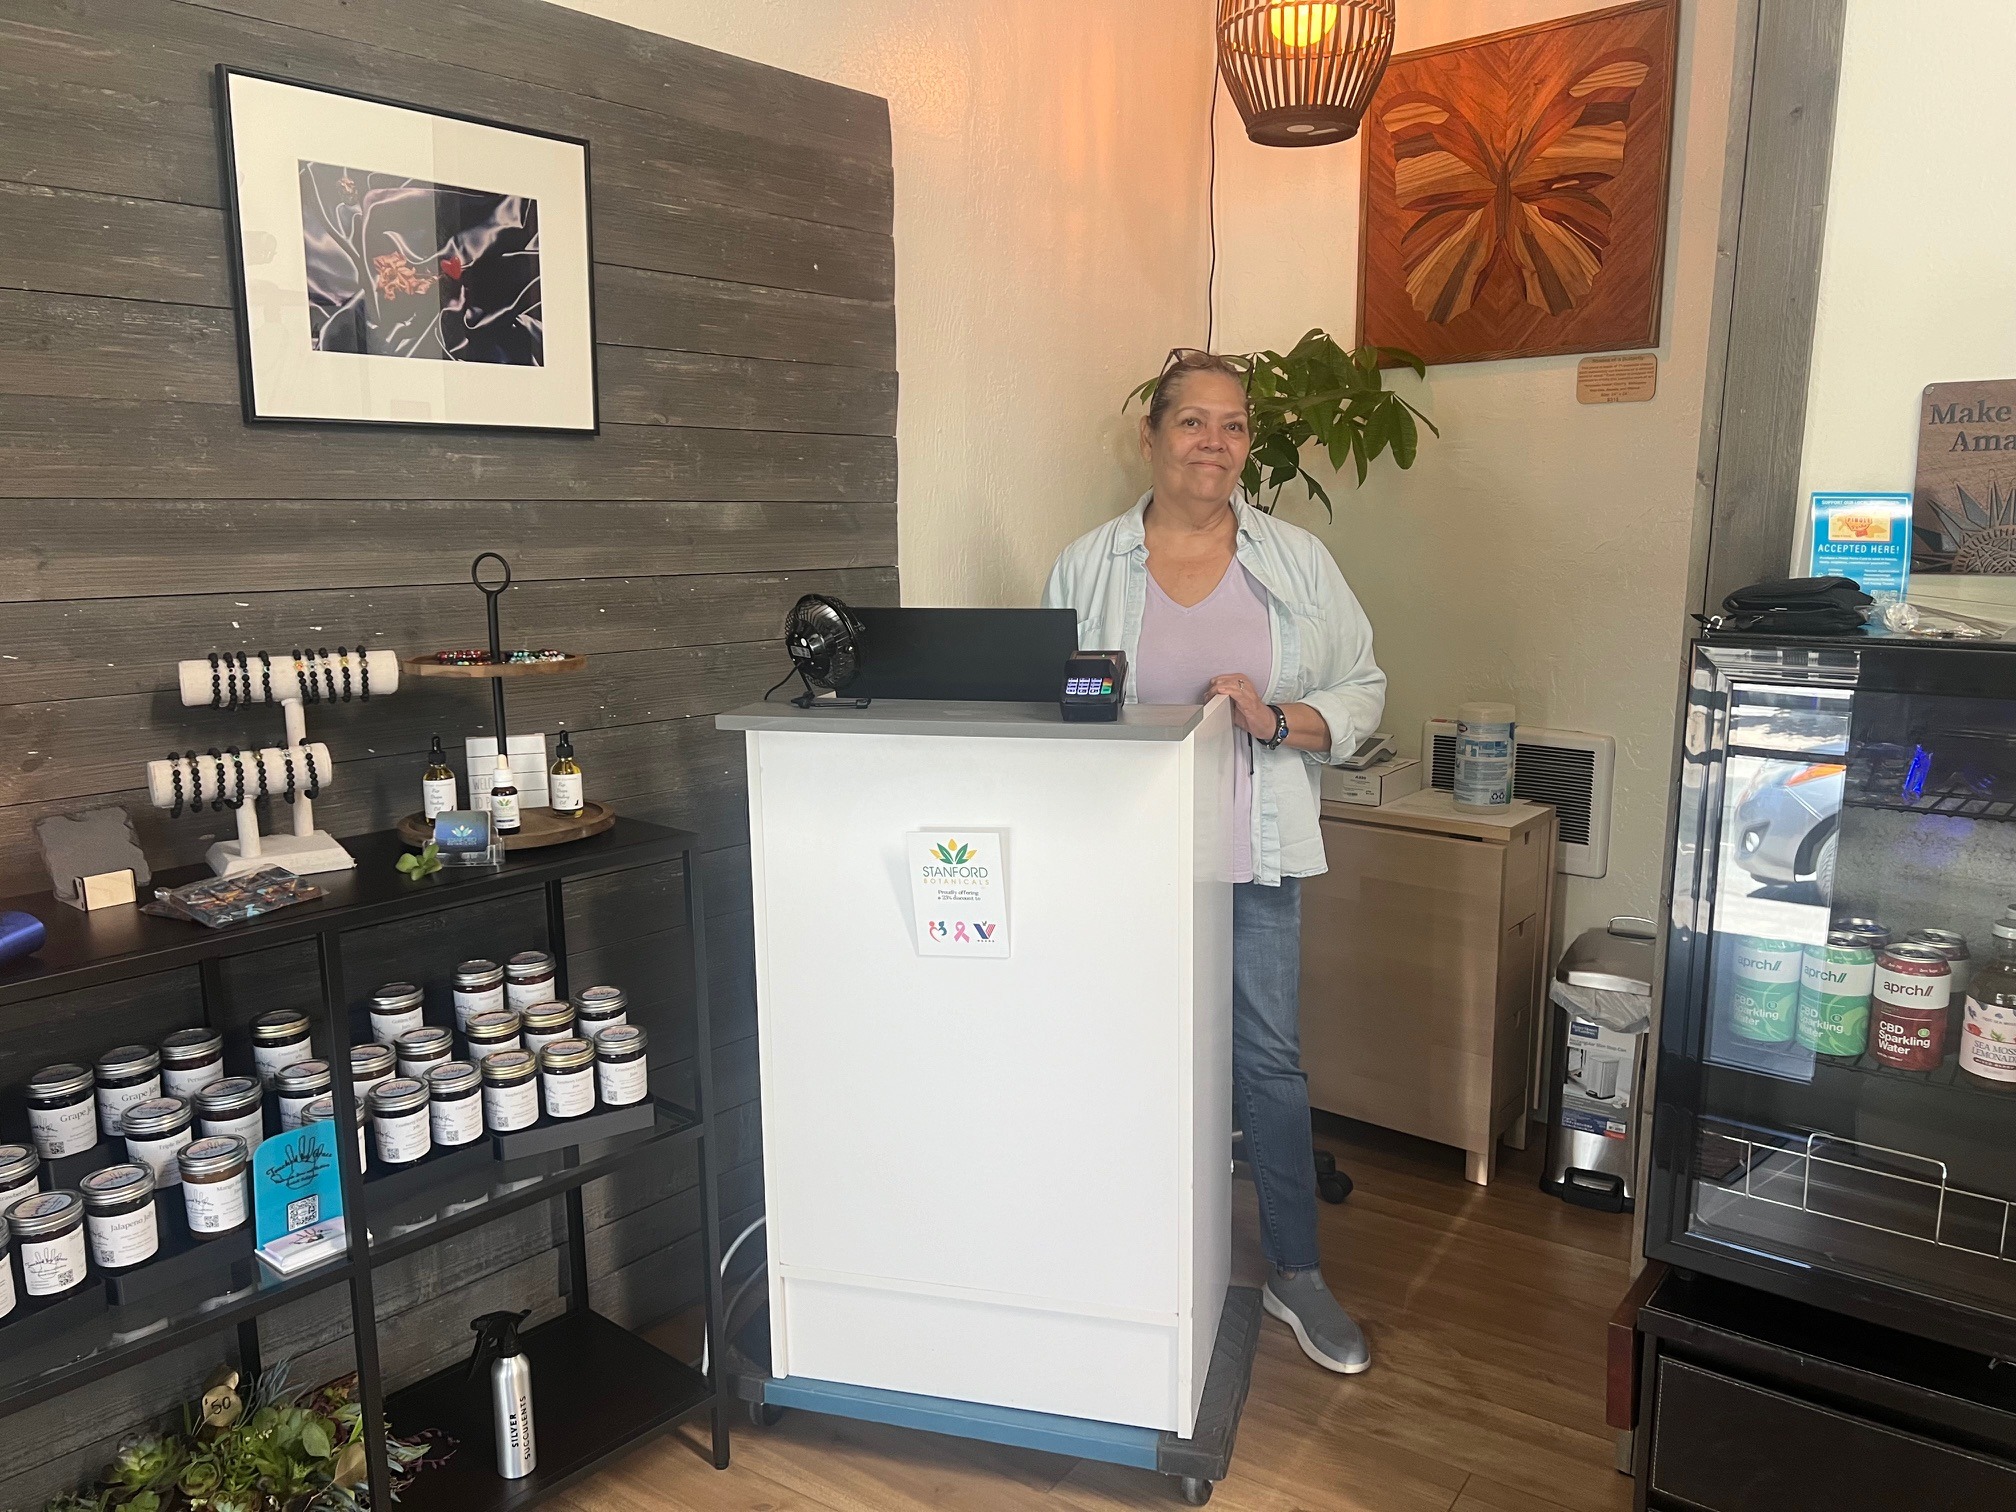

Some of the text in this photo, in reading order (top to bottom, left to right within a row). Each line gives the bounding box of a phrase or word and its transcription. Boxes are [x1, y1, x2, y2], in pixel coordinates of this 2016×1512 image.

[1929, 400, 2012, 426] Make
[1818, 544, 1900, 554] ACCEPTED HERE!
[922, 866, 988, 878] STANFORD
[1800, 1004, 1819, 1018] CBD
[1879, 1020, 1904, 1035] CBD
[1878, 1030, 1931, 1049] Sparkling
[1878, 1038, 1911, 1055] Water
[1973, 1040, 1991, 1052] SEA
[1971, 1046, 2016, 1063] LEMONAD
[121, 1089, 148, 1102] Grape
[60, 1109, 86, 1122] Grape
[1, 1189, 27, 1201] rawberry
[110, 1218, 143, 1232] Jalapeno
[509, 1413, 519, 1448] SILVER
[519, 1395, 531, 1460] SUCCULENTS
